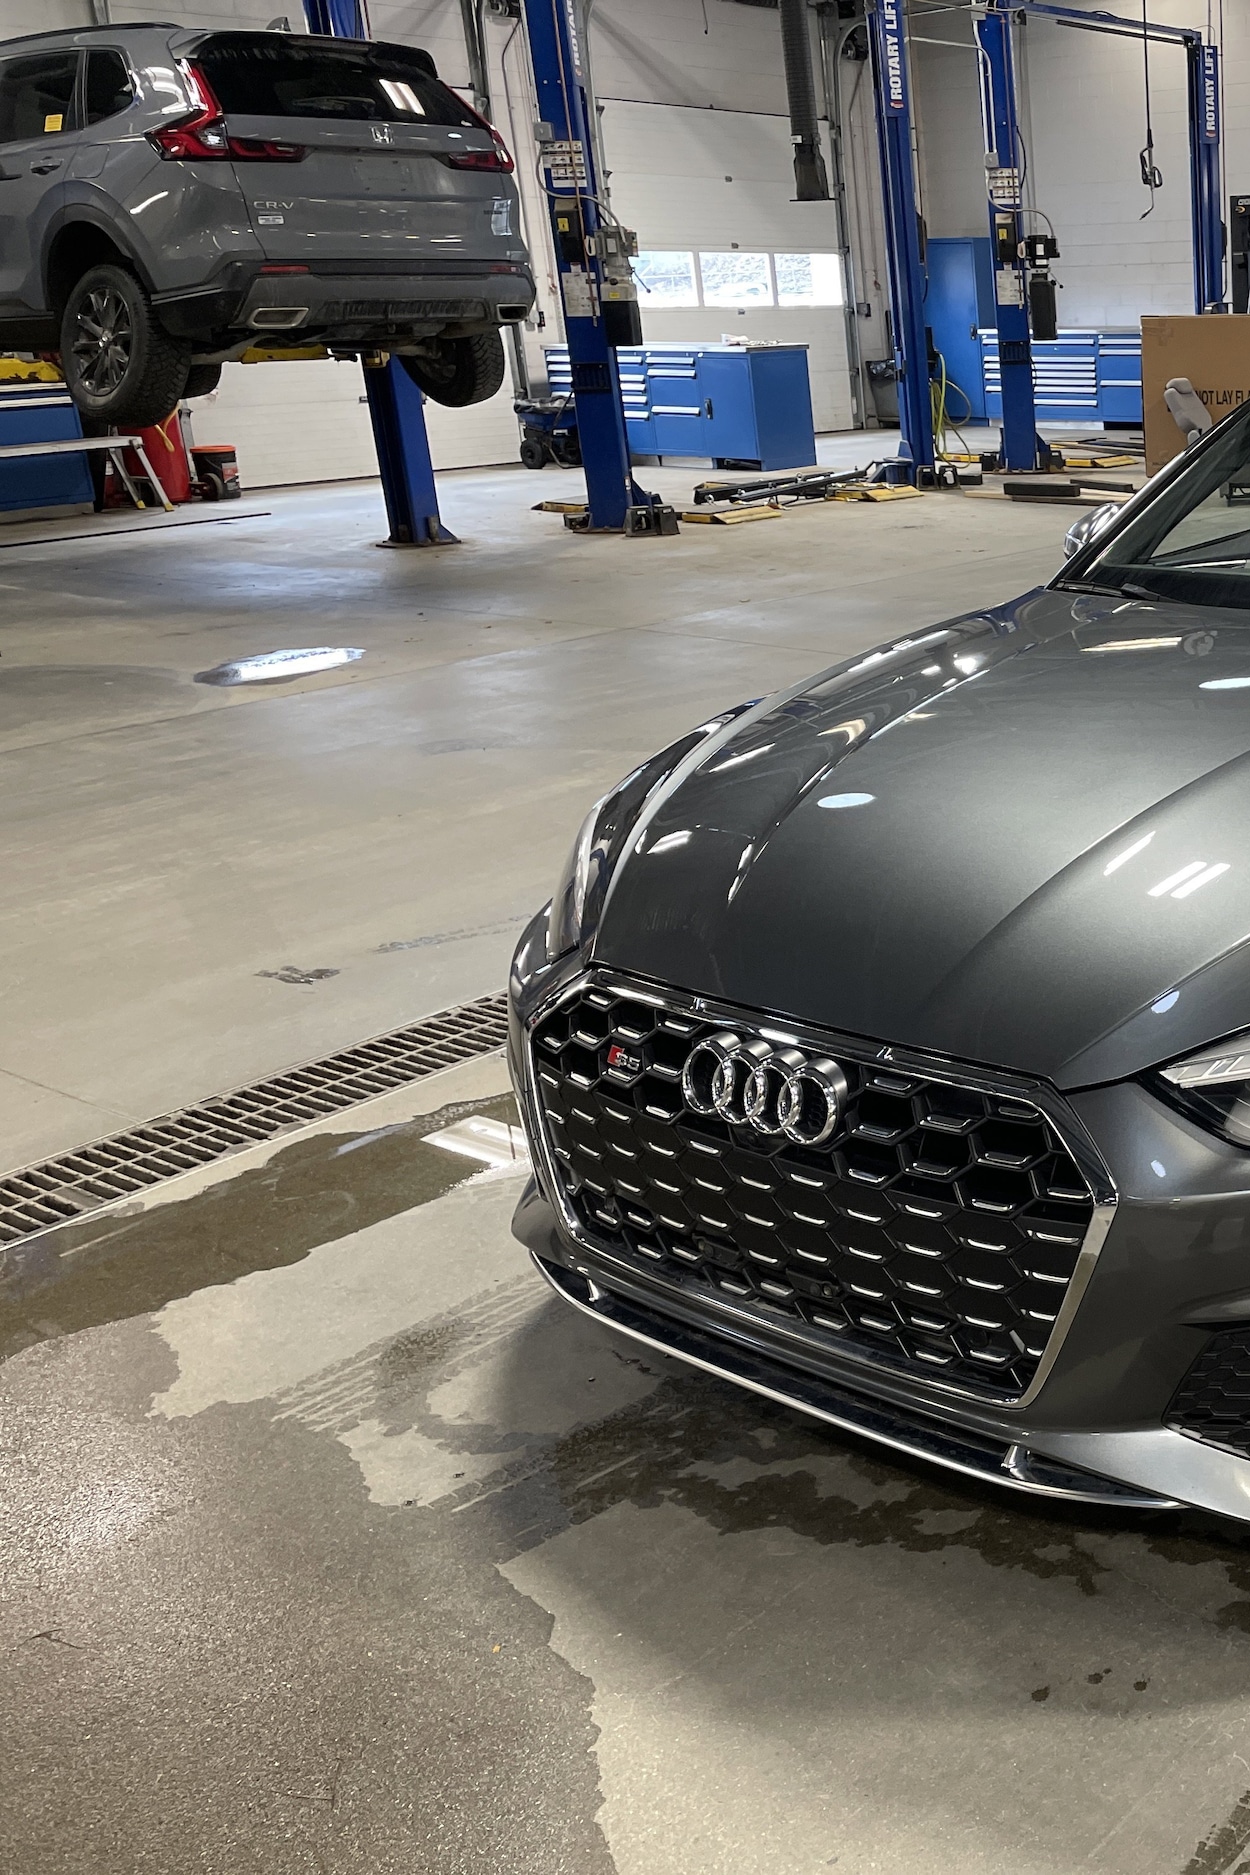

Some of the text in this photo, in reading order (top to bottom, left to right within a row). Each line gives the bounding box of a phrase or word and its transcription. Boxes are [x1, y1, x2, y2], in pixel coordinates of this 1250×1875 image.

[886, 34, 902, 100] ROTARY
[1204, 46, 1216, 131] ROTARY LIFT
[253, 201, 294, 210] CR-V
[1216, 390, 1233, 405] LAY
